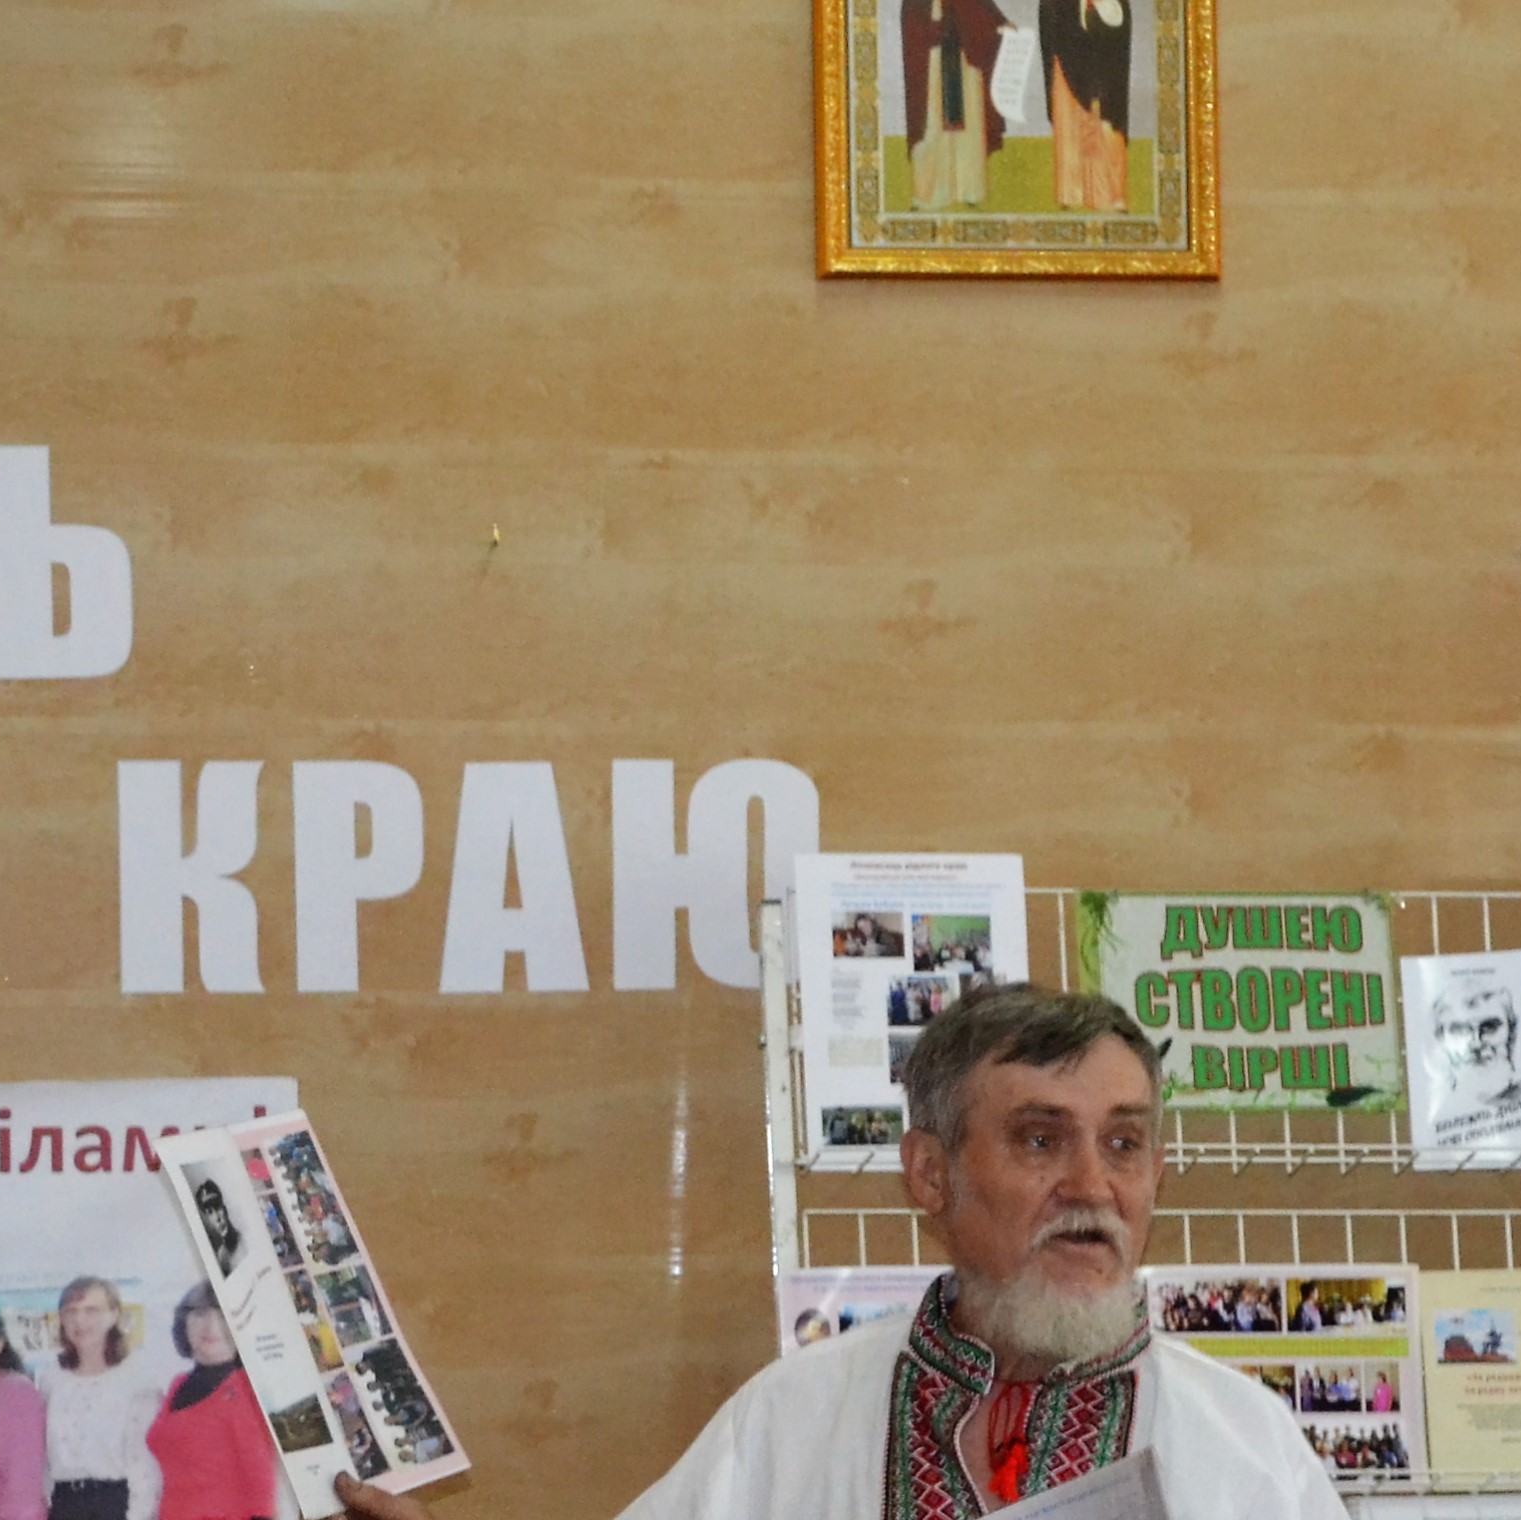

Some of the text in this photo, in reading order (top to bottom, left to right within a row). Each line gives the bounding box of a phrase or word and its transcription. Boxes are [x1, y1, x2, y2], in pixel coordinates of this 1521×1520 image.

[117, 758, 820, 993] КРАЮ
[1160, 904, 1363, 961] ДУШЕЮ
[1134, 964, 1386, 1034] СТВОРЕНІ
[1191, 1041, 1352, 1092] ВІРШІ
